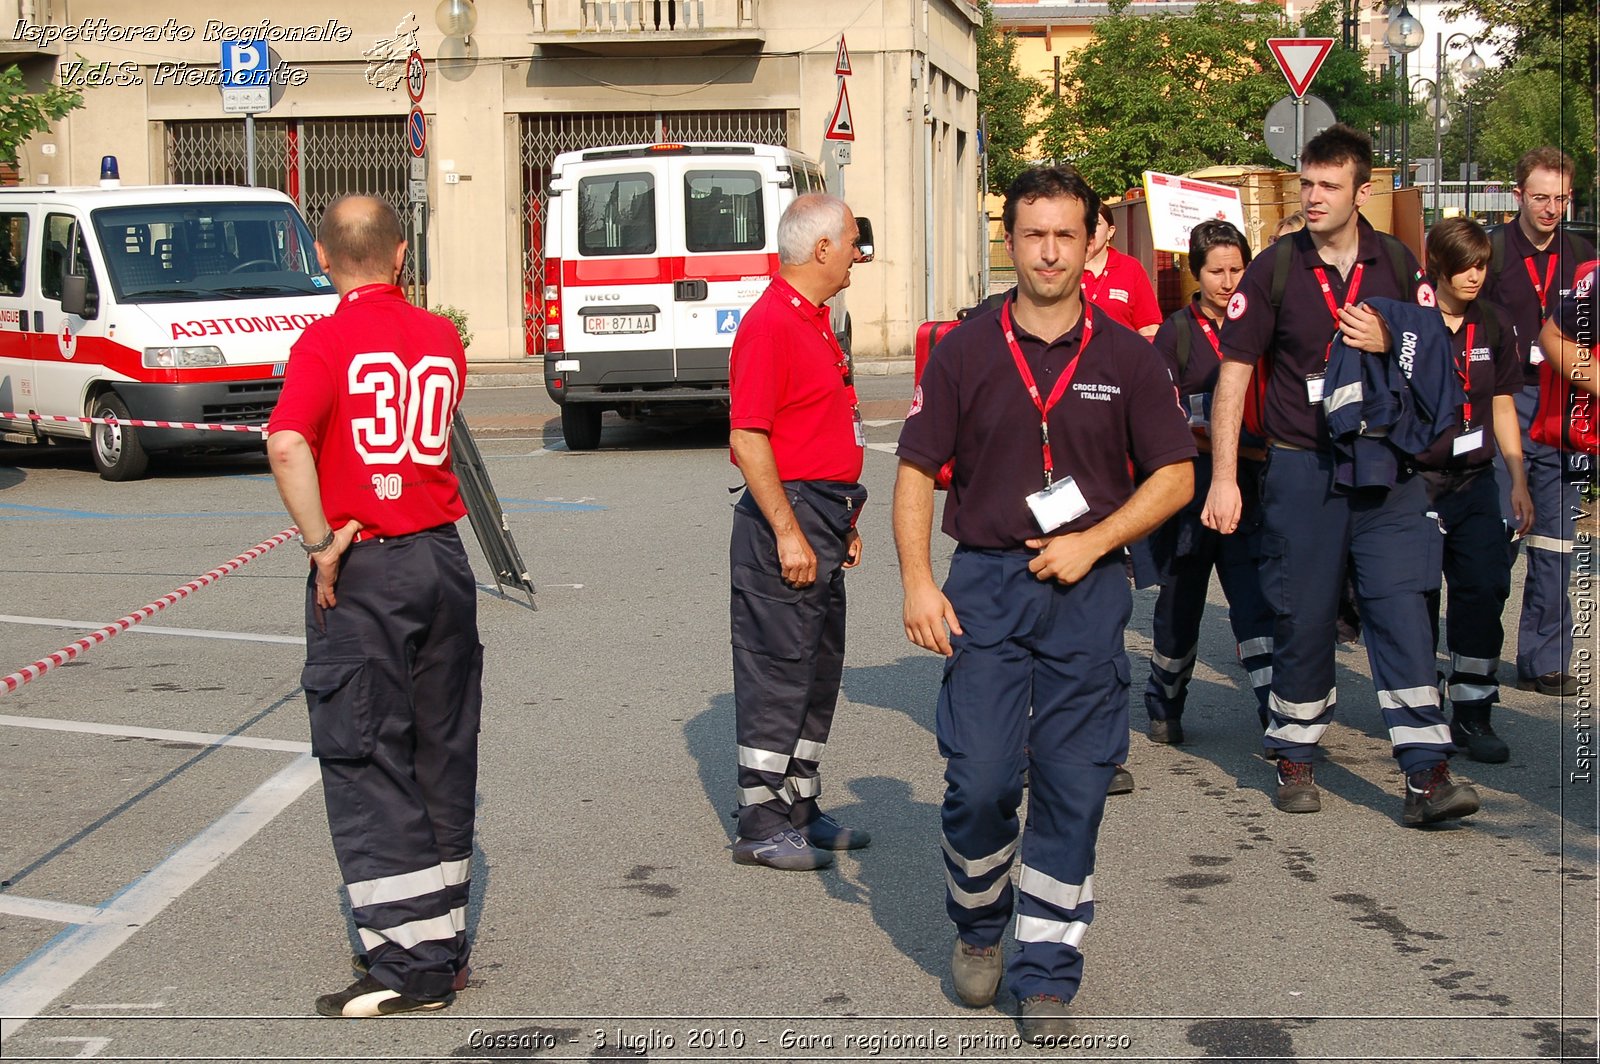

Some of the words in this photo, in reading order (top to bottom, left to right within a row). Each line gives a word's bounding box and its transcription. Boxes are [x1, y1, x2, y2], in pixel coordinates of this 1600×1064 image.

[585, 293, 621, 301] IVECO
[588, 318, 605, 330] CRI
[612, 317, 632, 330] 871
[636, 317, 650, 329] AA
[1072, 383, 1097, 392] CROCE
[1098, 384, 1121, 394] ROSSA
[1080, 392, 1111, 401] ITALIANA
[348, 352, 460, 466] 30
[371, 473, 402, 500] 30
